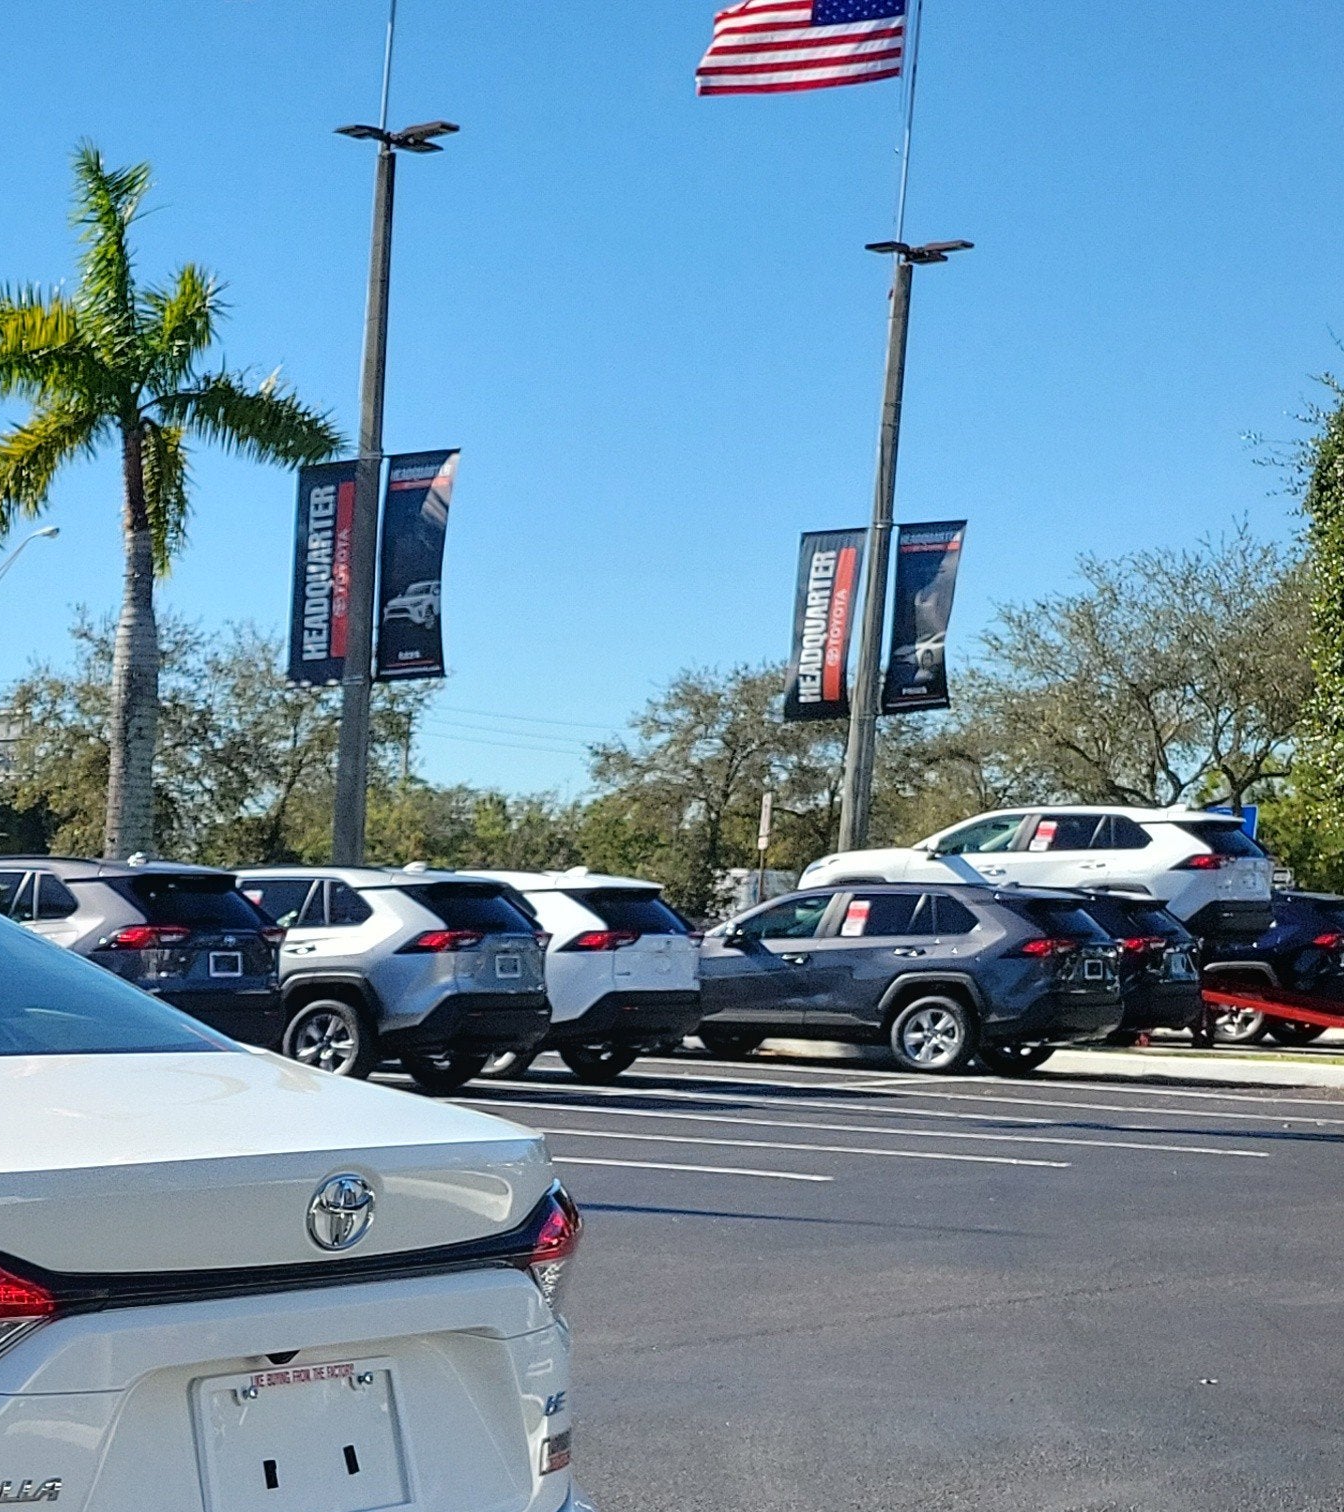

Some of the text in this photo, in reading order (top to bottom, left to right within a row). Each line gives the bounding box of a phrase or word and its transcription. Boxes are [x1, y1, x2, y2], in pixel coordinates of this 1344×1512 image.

[302, 484, 337, 662] HEADQUARTER
[798, 550, 837, 704] HEADQUARTER
[827, 588, 849, 647] TOYOTA
